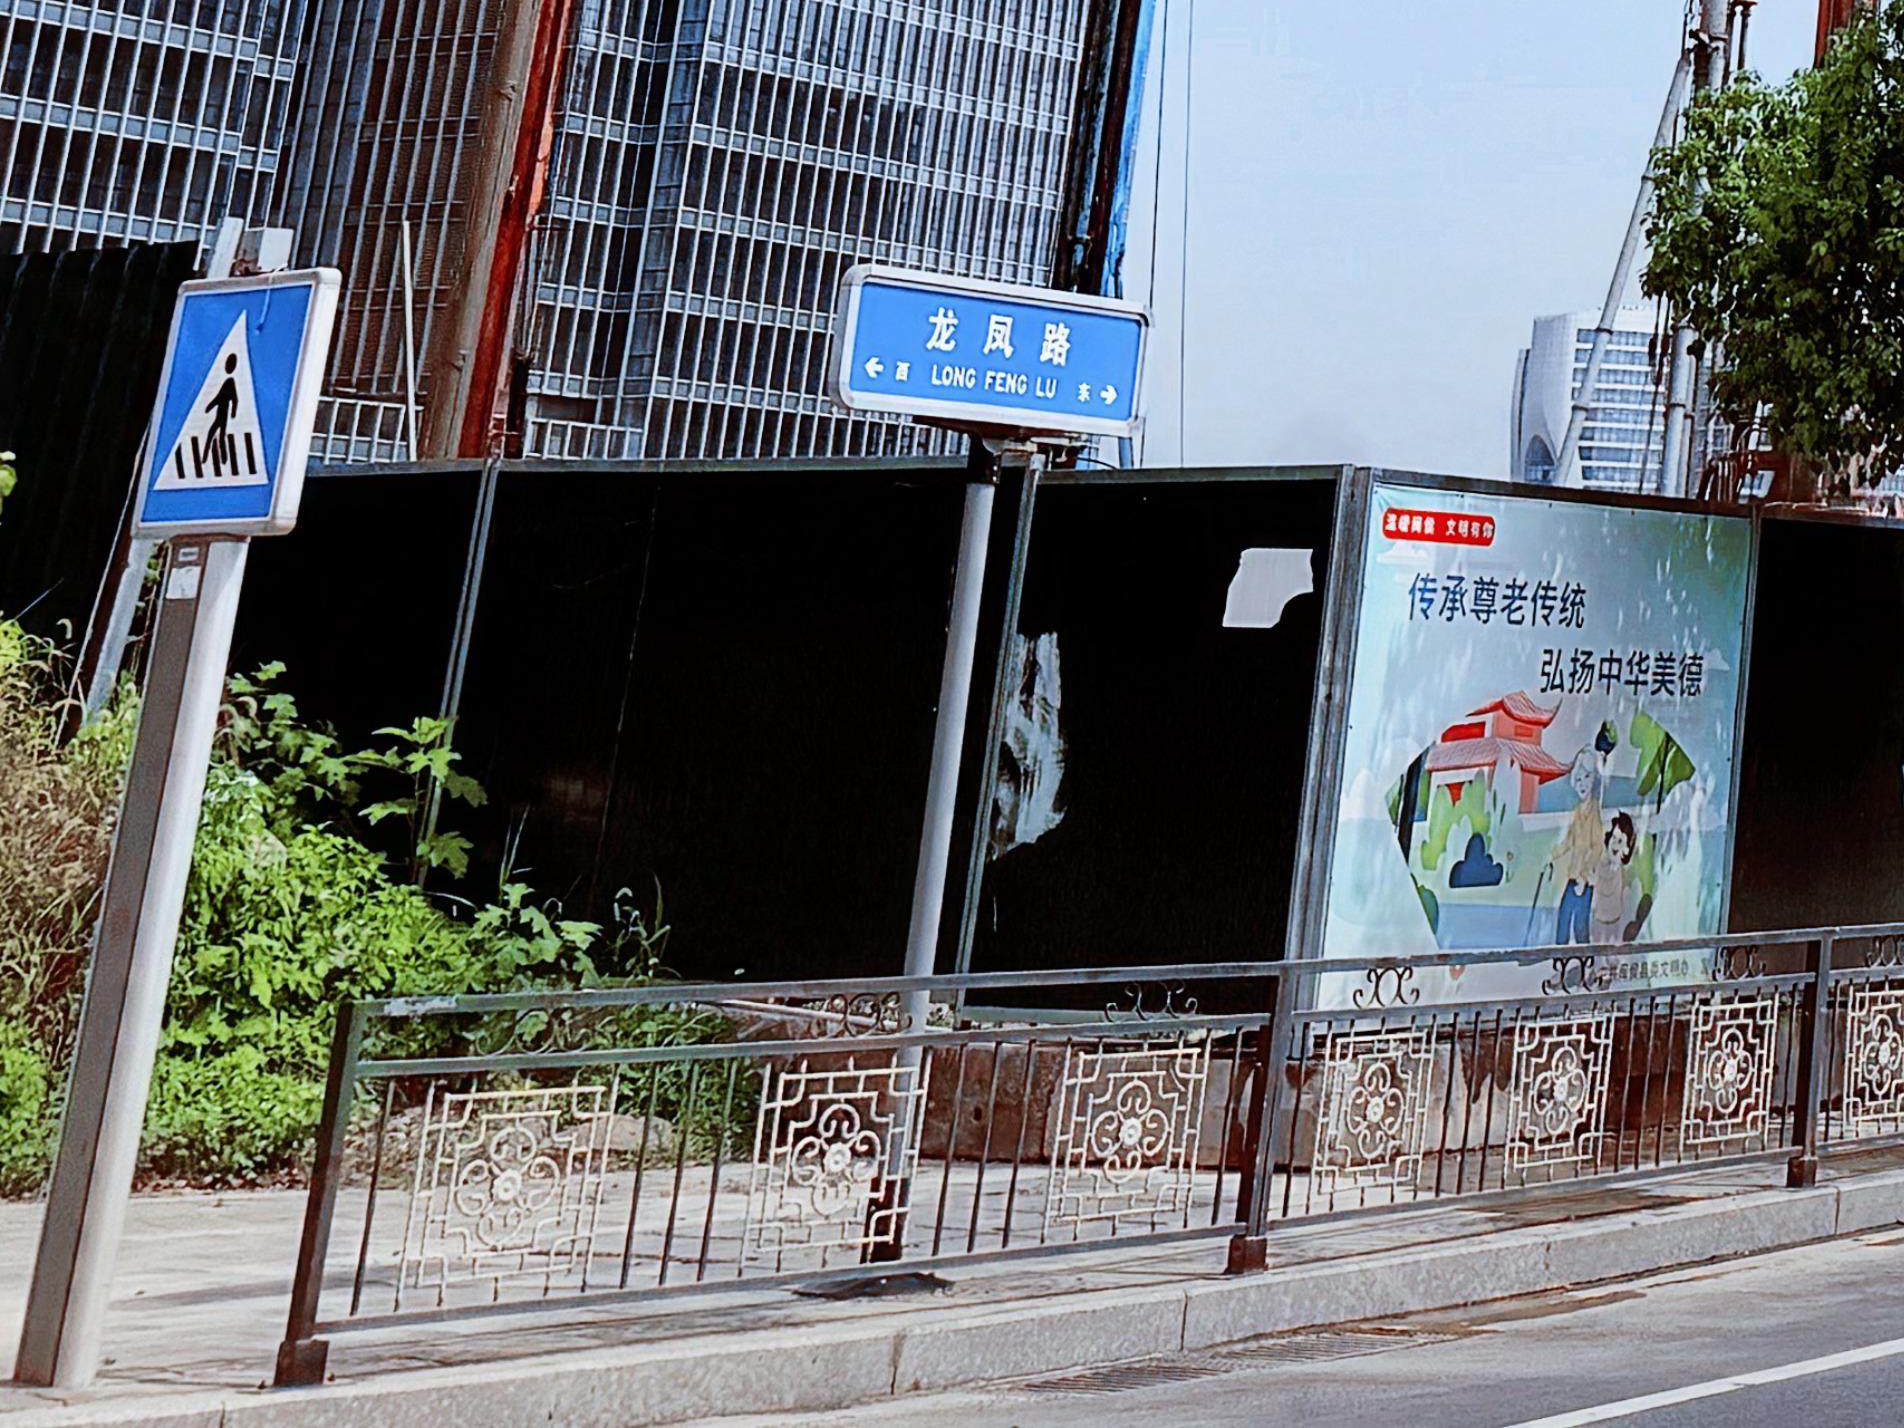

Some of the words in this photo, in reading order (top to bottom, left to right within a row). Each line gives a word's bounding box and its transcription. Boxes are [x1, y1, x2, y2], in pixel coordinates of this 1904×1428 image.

[925, 306, 1071, 367] 龙凤路
[895, 361, 911, 382] 西
[931, 363, 976, 389] LONG
[984, 370, 1028, 395] FENG
[1035, 376, 1058, 399] LU
[1077, 382, 1091, 403] 东
[1408, 572, 1587, 629] 传承尊老传统
[1539, 647, 1704, 697] 弘扬中华美德
